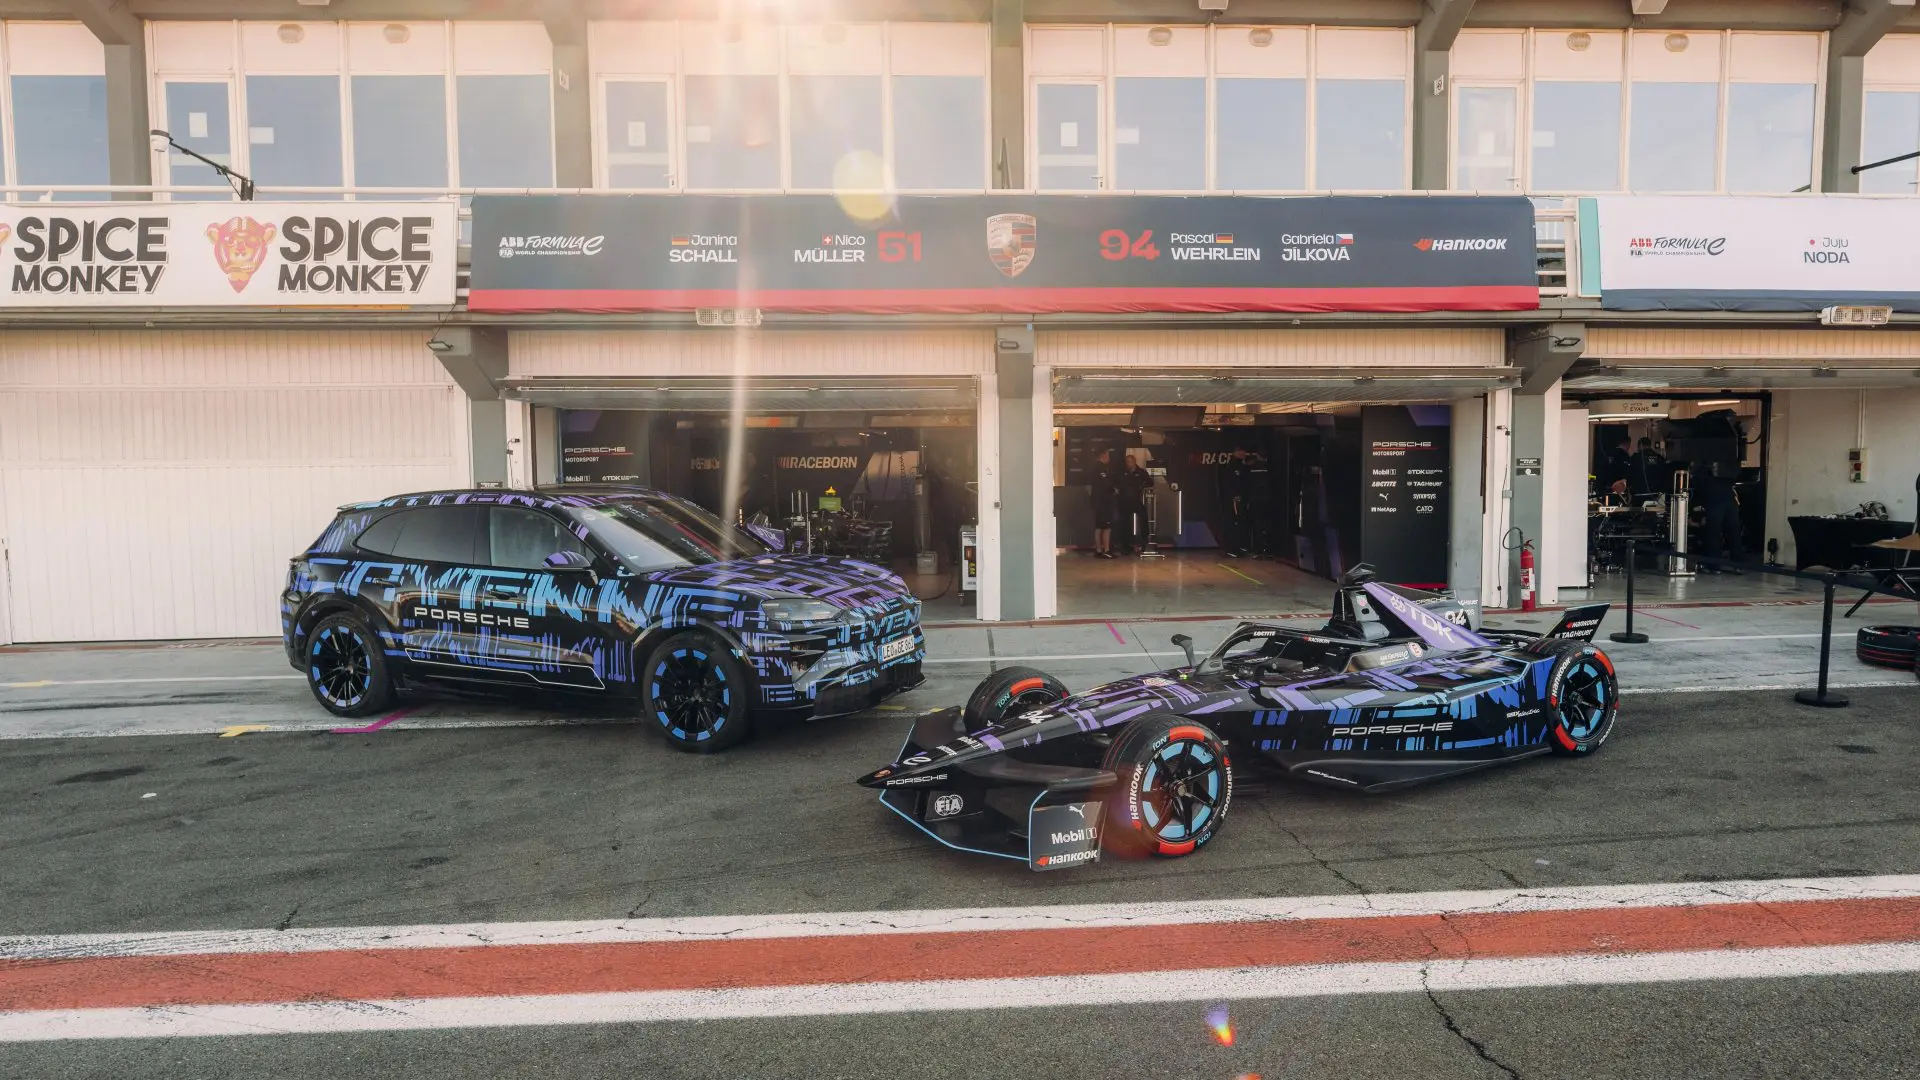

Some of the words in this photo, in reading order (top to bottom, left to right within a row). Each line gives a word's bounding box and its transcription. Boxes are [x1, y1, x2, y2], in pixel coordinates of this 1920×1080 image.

[14, 217, 169, 262] SPICE
[280, 217, 433, 262] SPICE
[499, 236, 525, 248] ABB
[691, 235, 738, 246] Janina
[835, 235, 866, 246] Nico
[1098, 229, 1160, 261] 94
[1171, 232, 1215, 244] Pascal
[1281, 233, 1335, 246] Gabriela
[1629, 238, 1653, 248] ABB
[876, 231, 922, 263] 51
[1171, 247, 1261, 261] WEHRLEIN
[669, 249, 738, 263] SCHALL
[794, 247, 865, 263] MÜLLER
[1803, 252, 1850, 264] NODA
[12, 264, 164, 293] MONKEY
[277, 264, 430, 293] MONKEY
[565, 456, 600, 464] MOTORSPORT
[789, 456, 858, 469] RACEBORN
[1372, 468, 1390, 476] Mobil
[414, 606, 530, 629] PORSCHE
[1403, 602, 1456, 644] TDK
[1332, 721, 1454, 737] PORSCHE
[886, 773, 948, 786] PORSCHE
[937, 796, 962, 814] FIA
[1051, 829, 1085, 845] Mobil
